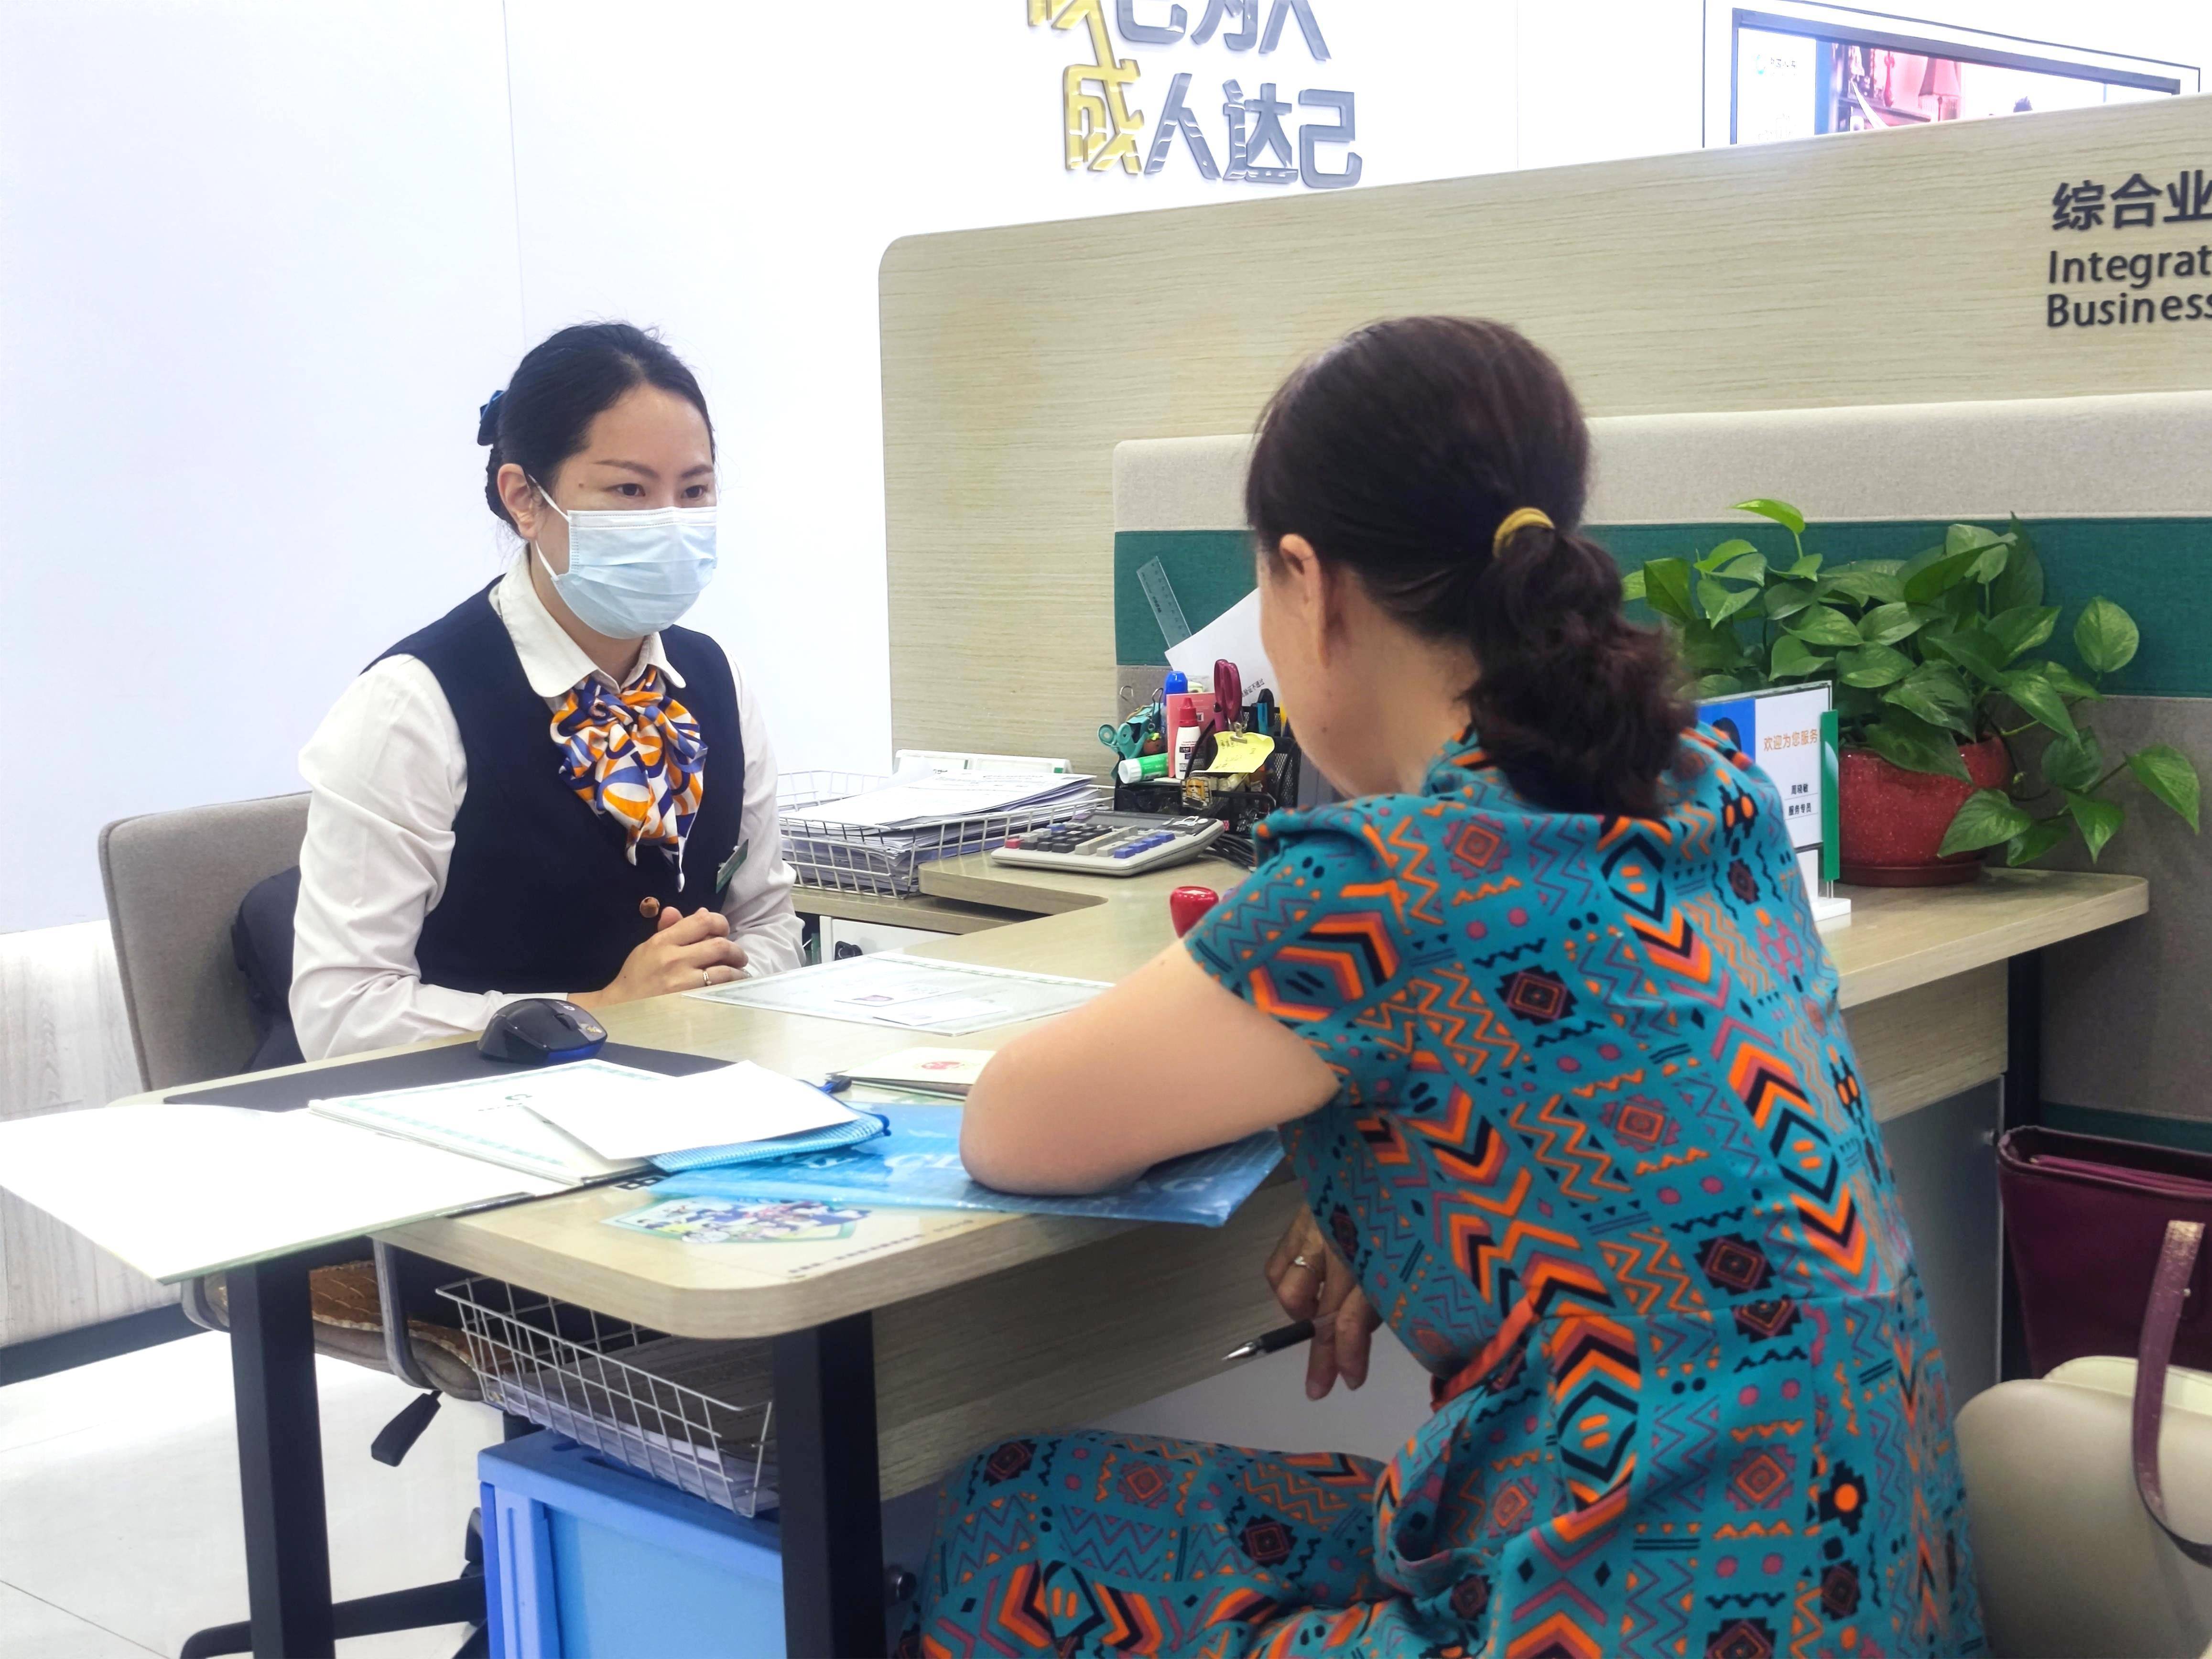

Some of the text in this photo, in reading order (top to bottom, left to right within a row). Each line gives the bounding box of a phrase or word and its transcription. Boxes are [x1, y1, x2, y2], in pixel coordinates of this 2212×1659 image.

[1063, 59, 1362, 188] 成人达己
[2052, 169, 2212, 230] 综合业
[2049, 245, 2212, 289] Integrat
[1242, 678, 1265, 697] 验证不通过
[1764, 729, 1818, 751] 欢迎为您服务
[1789, 803, 1811, 816] 服务专员
